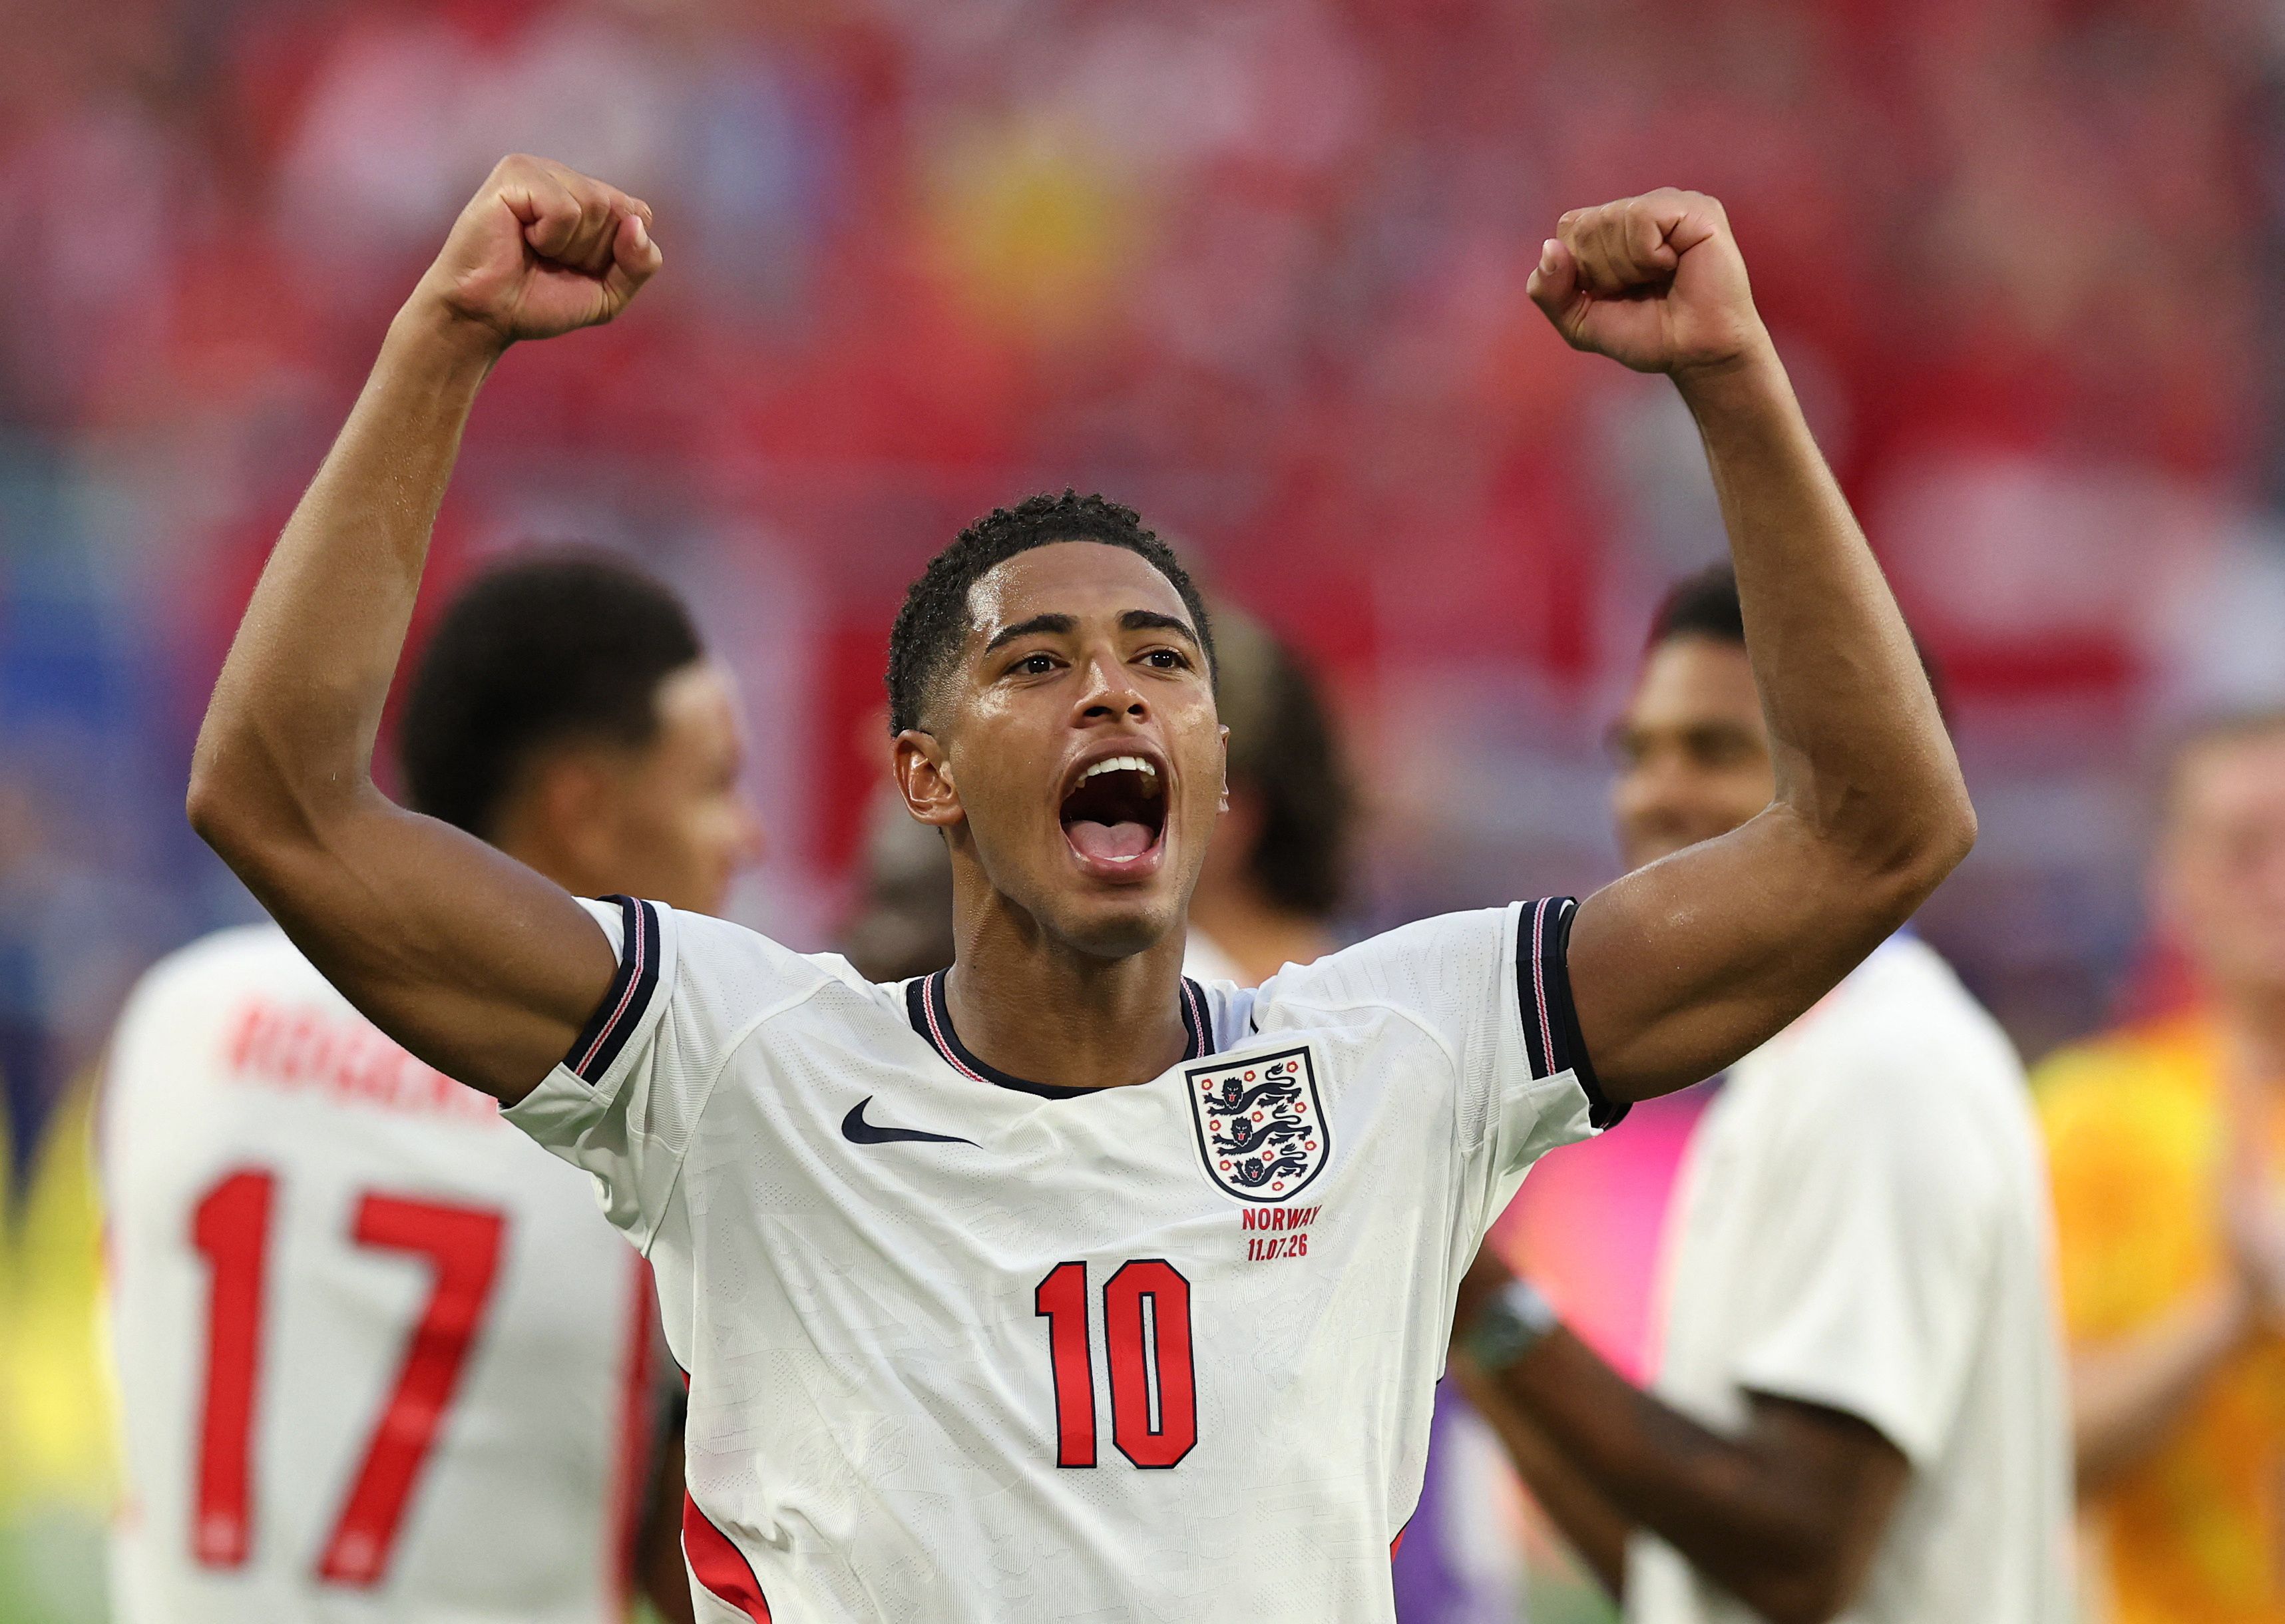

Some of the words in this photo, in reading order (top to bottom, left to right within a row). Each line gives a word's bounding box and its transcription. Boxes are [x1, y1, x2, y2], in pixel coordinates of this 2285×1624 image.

[1242, 1205, 1322, 1231] NORWAY
[1248, 1233, 1307, 1261] 11.07.26
[190, 1166, 507, 1587] 17
[1035, 1259, 1197, 1469] 10
